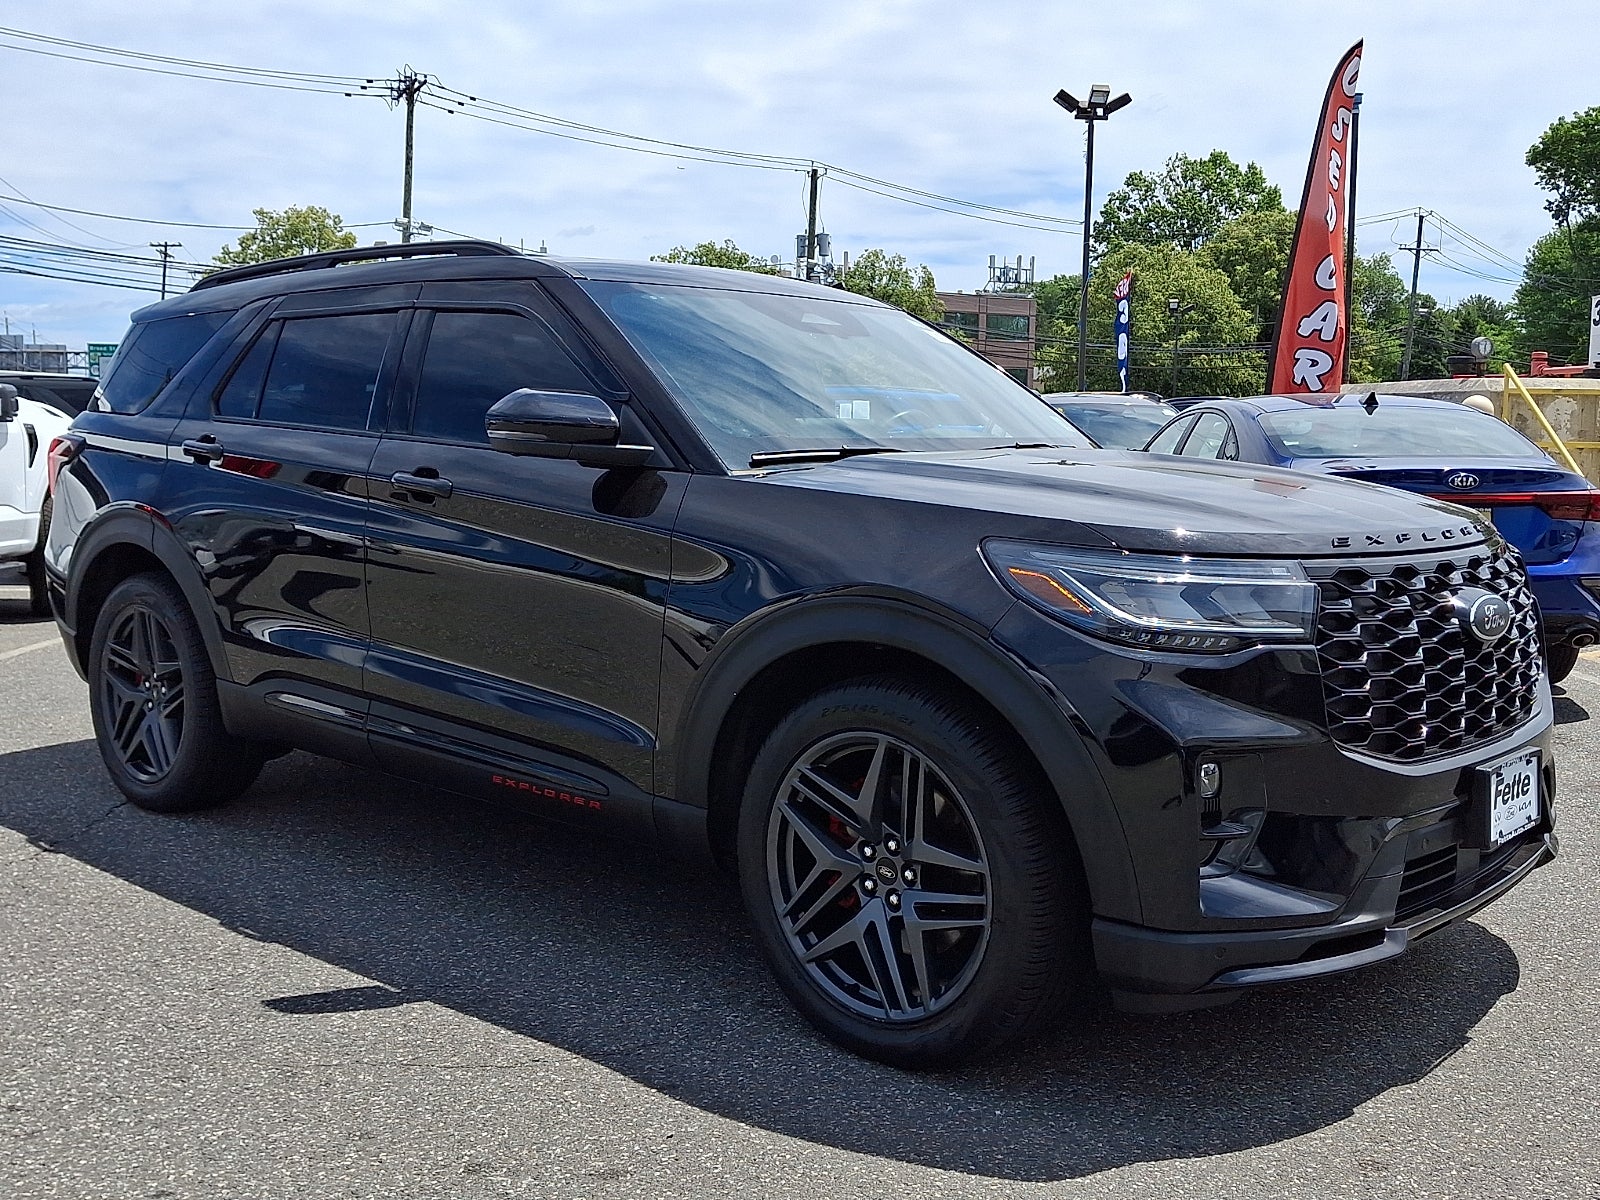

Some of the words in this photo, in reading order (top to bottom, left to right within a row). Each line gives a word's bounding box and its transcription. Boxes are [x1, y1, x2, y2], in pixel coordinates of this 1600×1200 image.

[1453, 476, 1475, 487] KIA
[492, 775, 601, 809] EXPLORER
[1494, 771, 1531, 811] Fette
